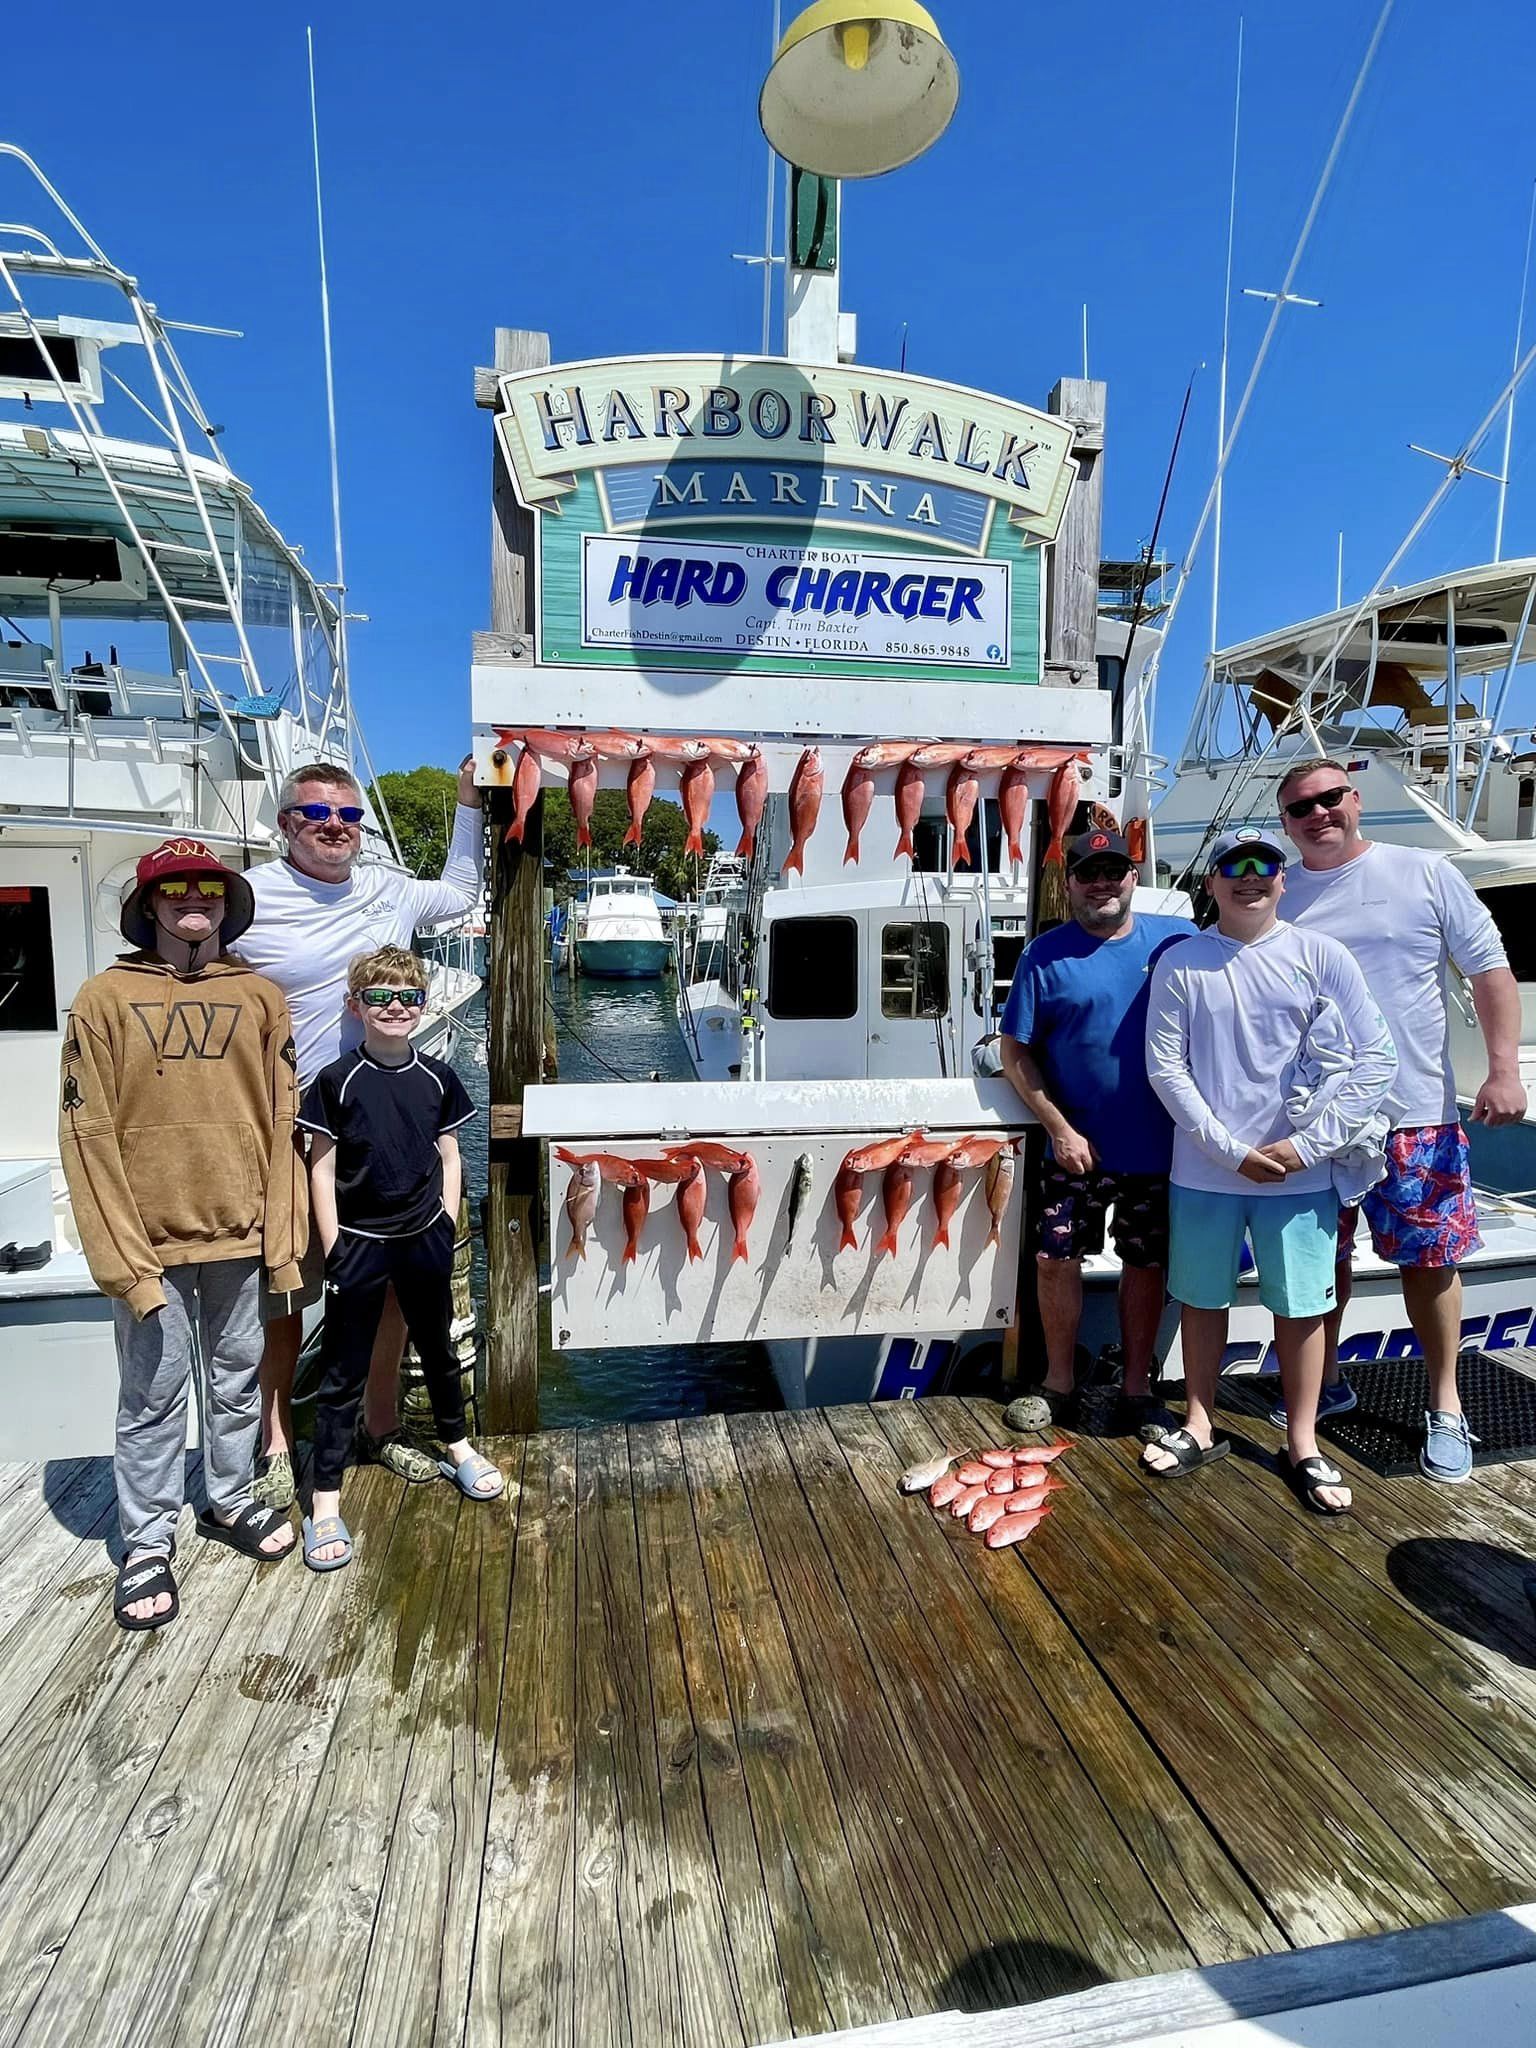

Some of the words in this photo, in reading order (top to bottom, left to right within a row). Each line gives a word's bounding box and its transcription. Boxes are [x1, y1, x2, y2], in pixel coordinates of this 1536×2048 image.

[653, 471, 942, 525] MARINA
[746, 546, 817, 562] CHARTER
[822, 551, 860, 564] BOAT
[608, 555, 748, 609] HARD
[765, 565, 986, 626] CHARGER
[745, 615, 780, 632] Capt.
[787, 618, 811, 631] Tim
[817, 620, 859, 634] Baxter
[591, 628, 722, 643] CharterFishDestin@gmail.com
[736, 634, 791, 648] DESTIN
[804, 638, 868, 651] FLORIDA
[885, 642, 970, 657] 850.865.9848
